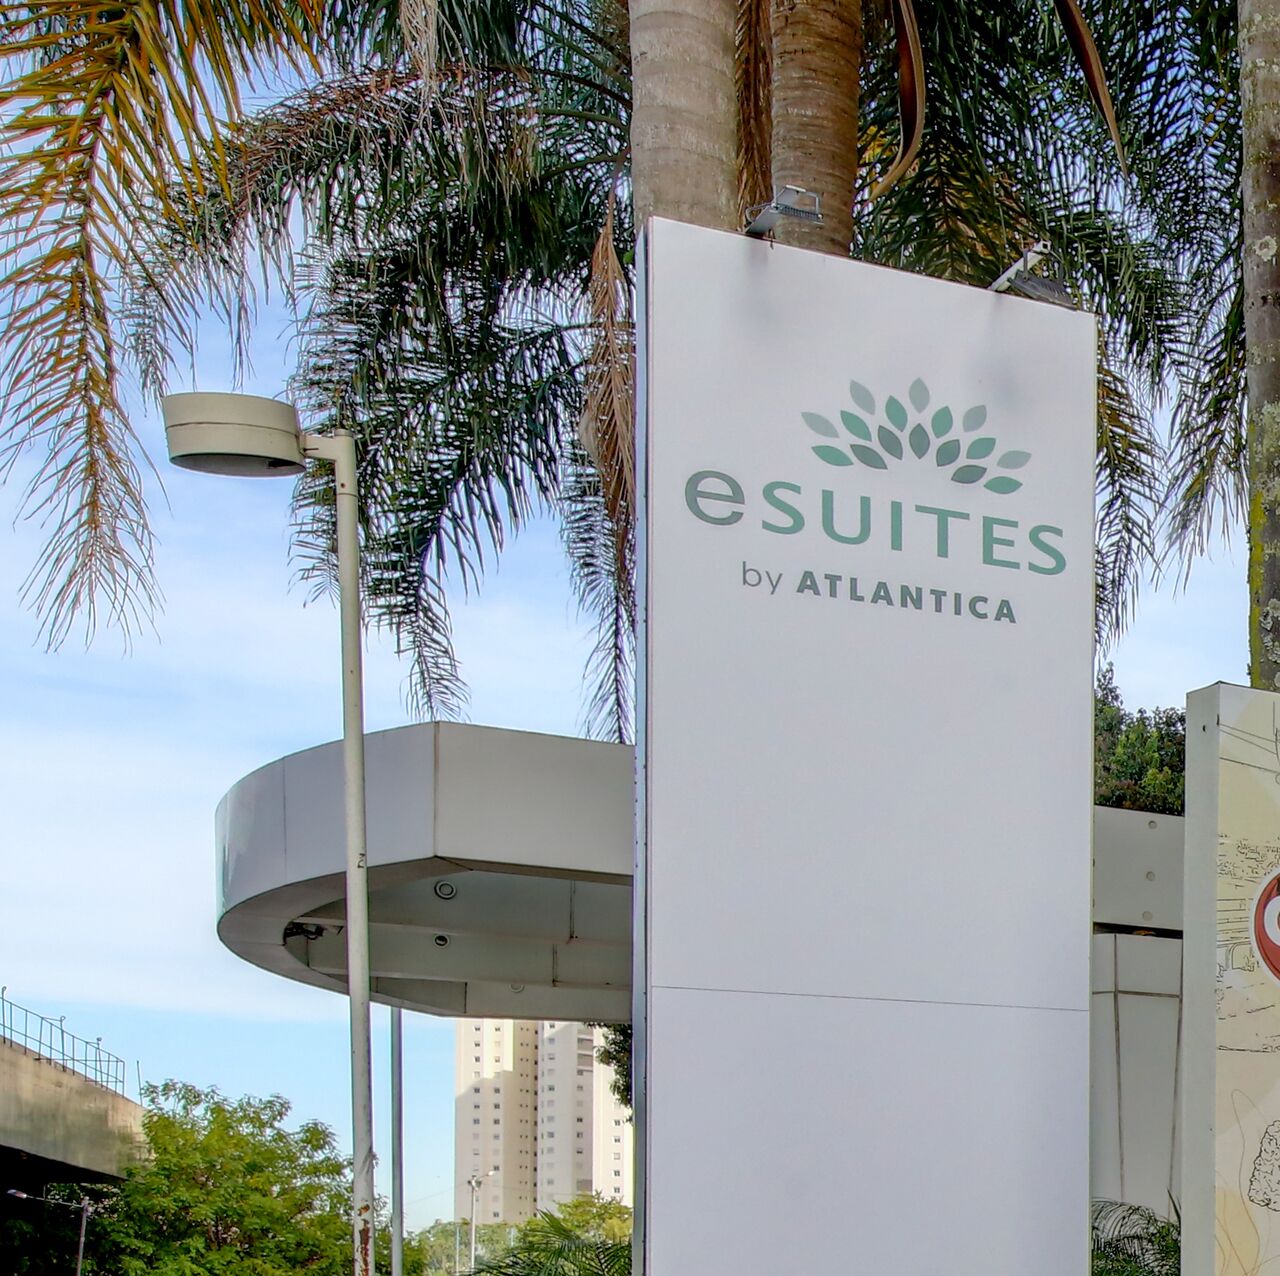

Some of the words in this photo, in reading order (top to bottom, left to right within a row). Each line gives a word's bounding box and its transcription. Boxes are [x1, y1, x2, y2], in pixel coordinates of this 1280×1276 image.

[684, 469, 1067, 576] eSUITES
[742, 561, 783, 594] by
[796, 570, 1017, 624] ATLANTICA
